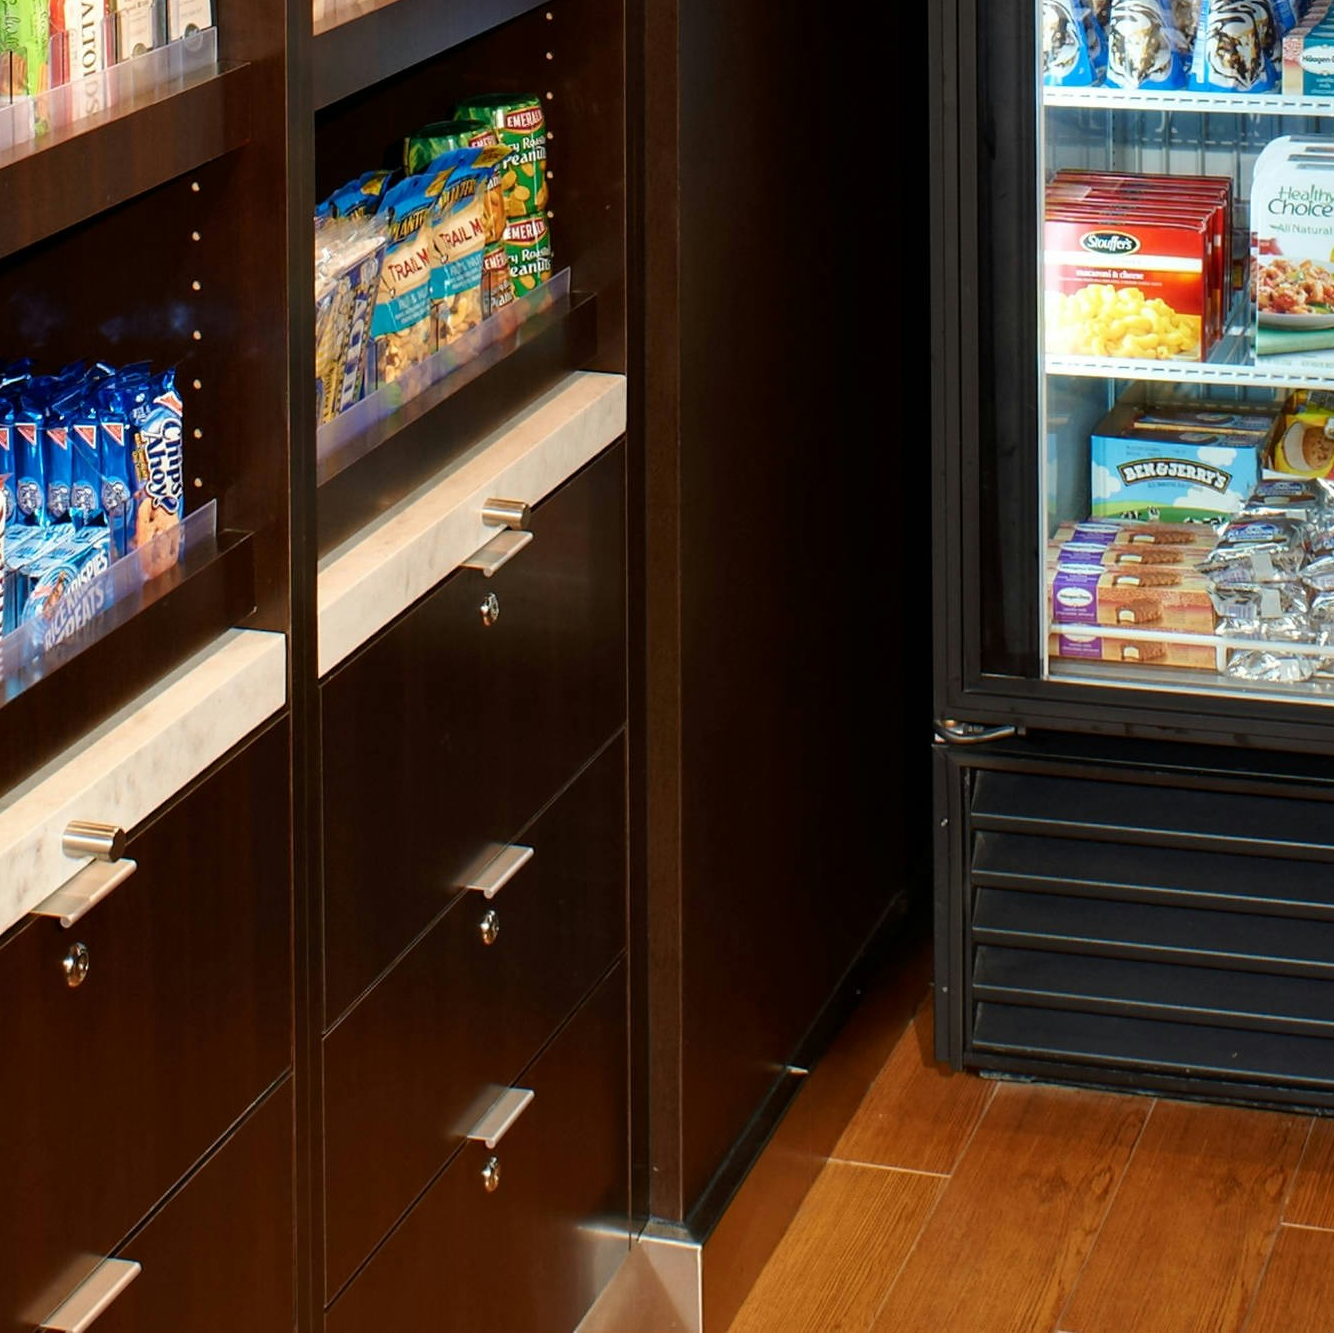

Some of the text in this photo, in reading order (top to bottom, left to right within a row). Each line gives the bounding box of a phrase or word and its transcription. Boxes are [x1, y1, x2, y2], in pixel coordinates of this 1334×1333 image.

[82, 2, 100, 116] ALTOIDS
[1267, 198, 1334, 218] Choice
[439, 228, 472, 249] TRAIL
[1277, 223, 1334, 236] All Natural
[1087, 234, 1135, 253] Stouffer's
[388, 259, 423, 282] TRAIL
[1076, 268, 1113, 280] macaroni
[1120, 269, 1145, 280] cheese
[164, 418, 183, 498] Chips
